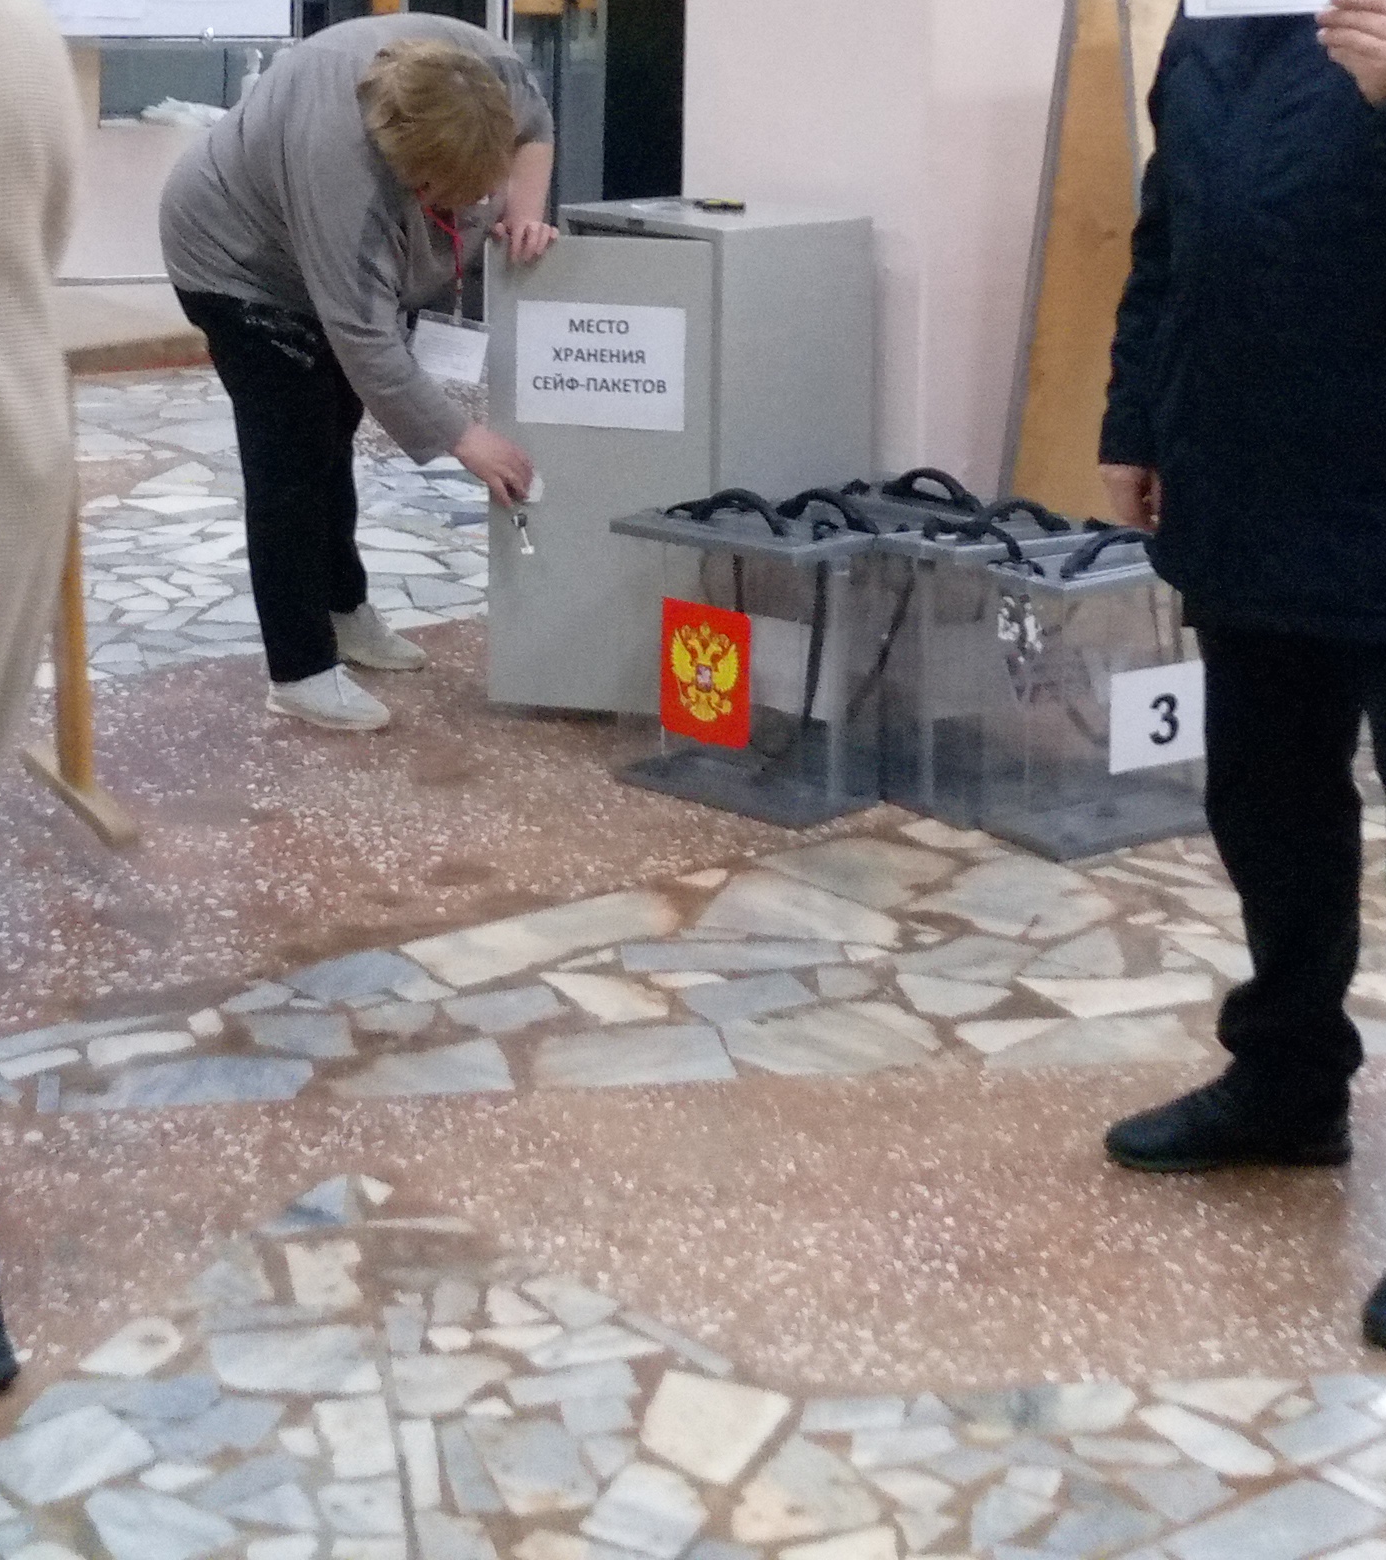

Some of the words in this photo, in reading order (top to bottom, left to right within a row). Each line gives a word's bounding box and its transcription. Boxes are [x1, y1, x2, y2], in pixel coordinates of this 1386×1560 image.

[568, 319, 629, 334] МЕСТО
[552, 347, 646, 364] ХРАНЕНИЯ
[532, 373, 668, 394] СЕЙФ-ПАКЕТОВ
[1148, 692, 1180, 746] 3
